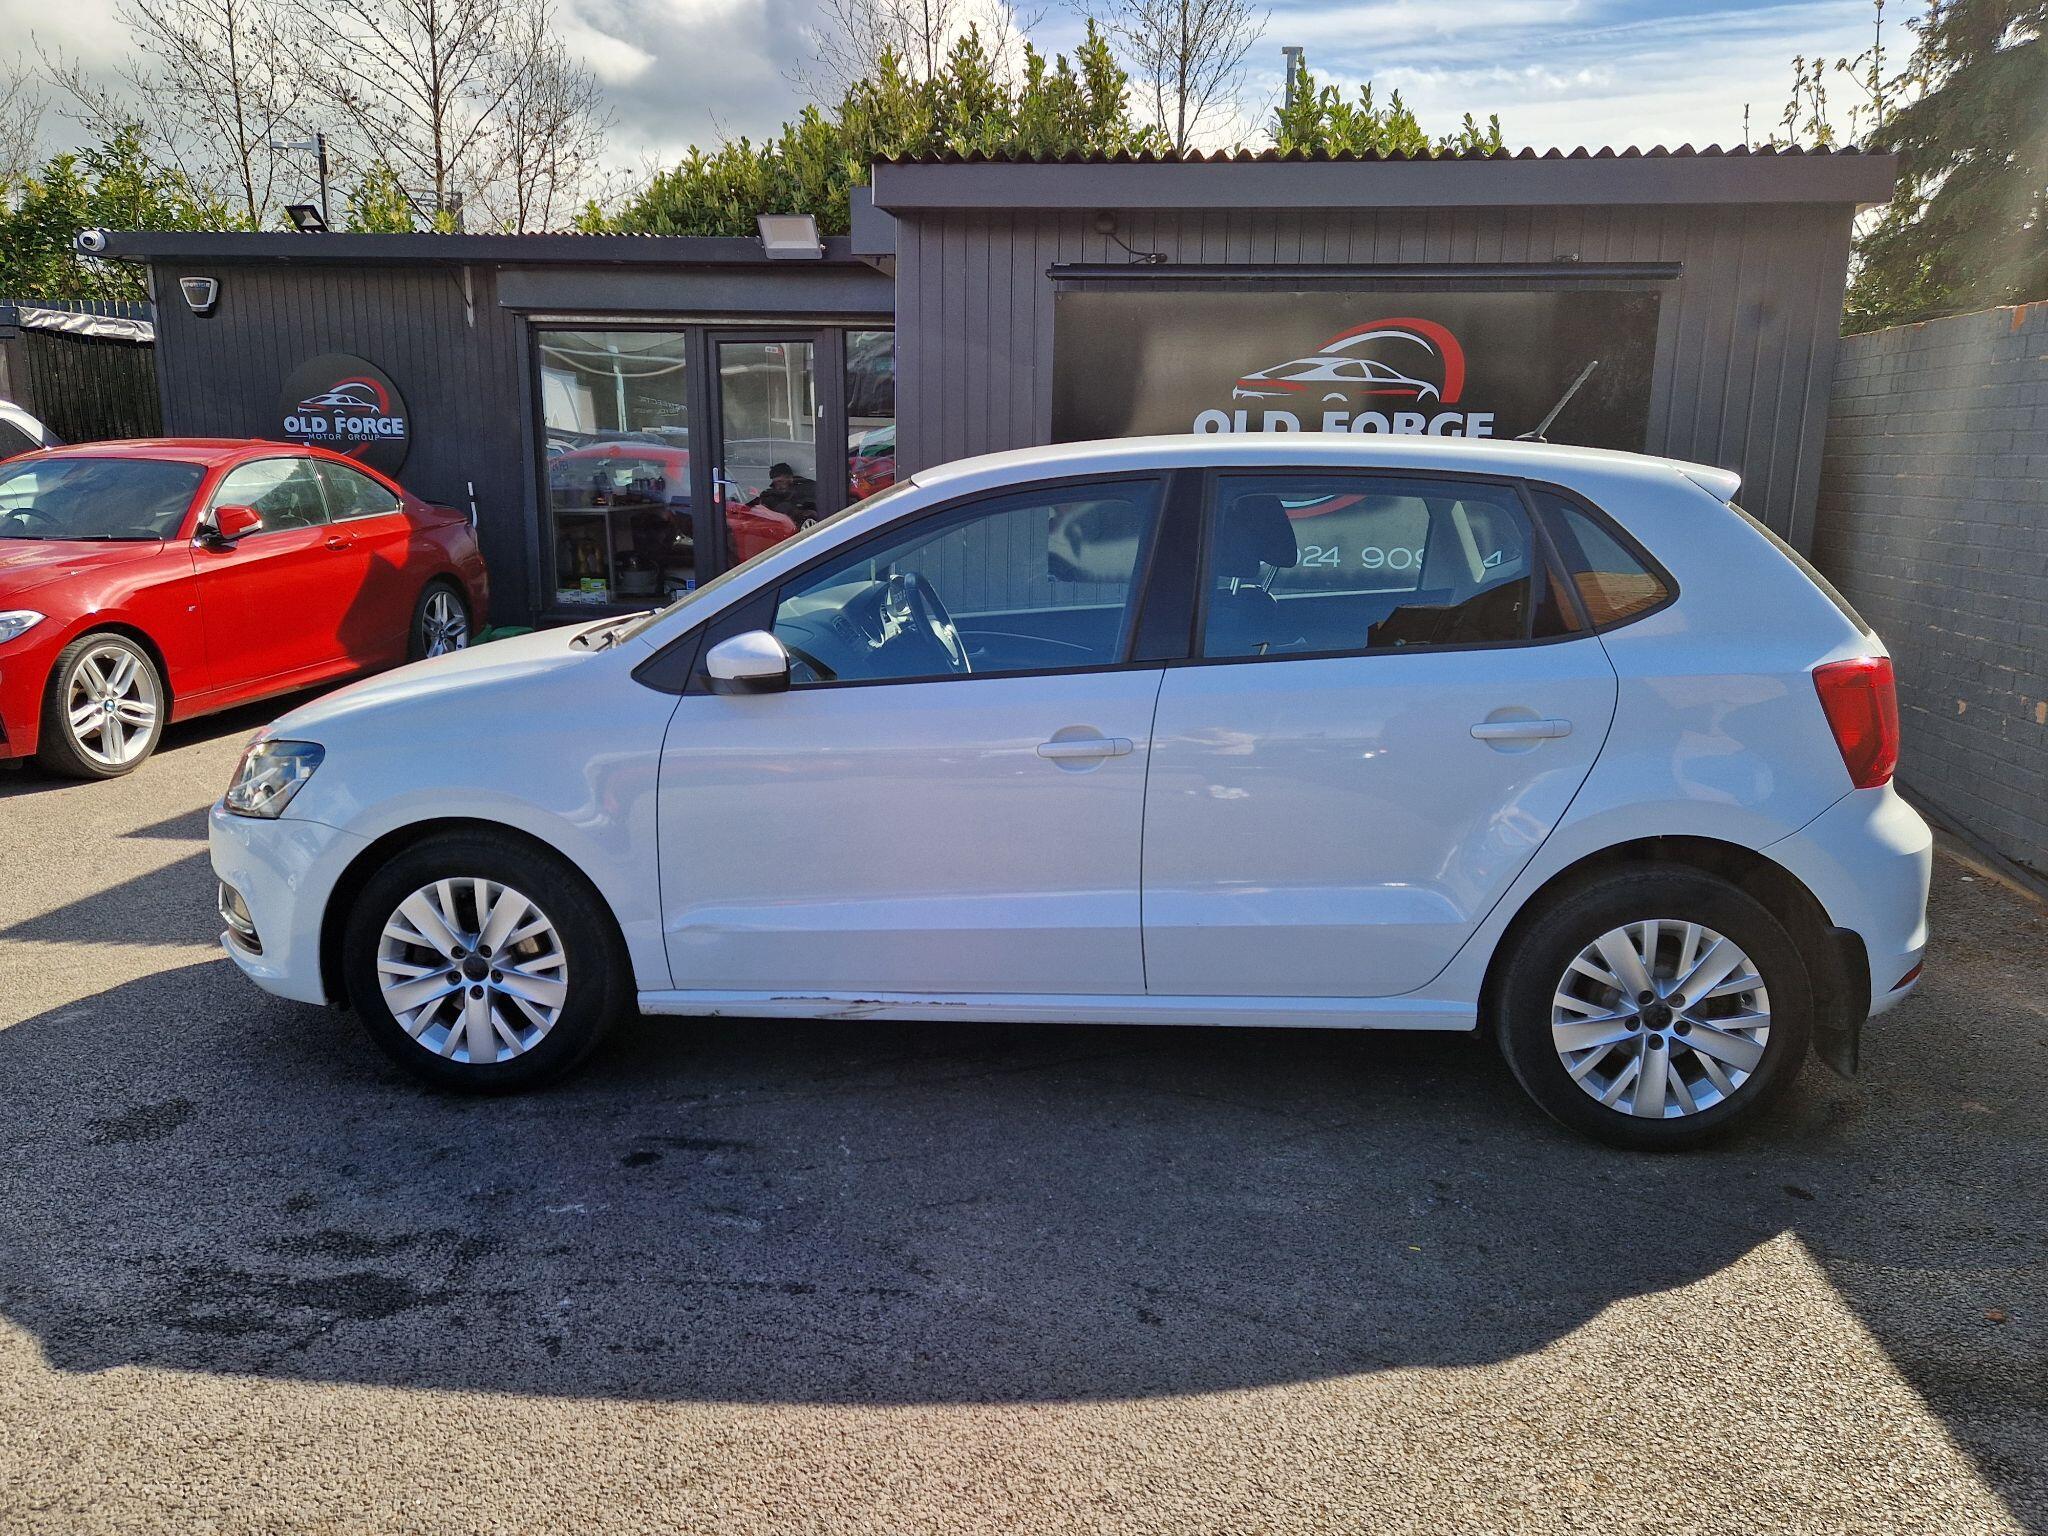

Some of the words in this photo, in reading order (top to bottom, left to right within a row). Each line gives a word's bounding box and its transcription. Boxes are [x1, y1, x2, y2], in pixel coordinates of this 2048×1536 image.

[283, 416, 328, 433] OLD
[334, 417, 404, 434] FORGE
[1193, 409, 1300, 434] OLD
[1322, 411, 1495, 437] FORGE
[307, 433, 341, 441] MOTOR
[347, 433, 380, 441] GROUP
[1297, 545, 1341, 568] 24
